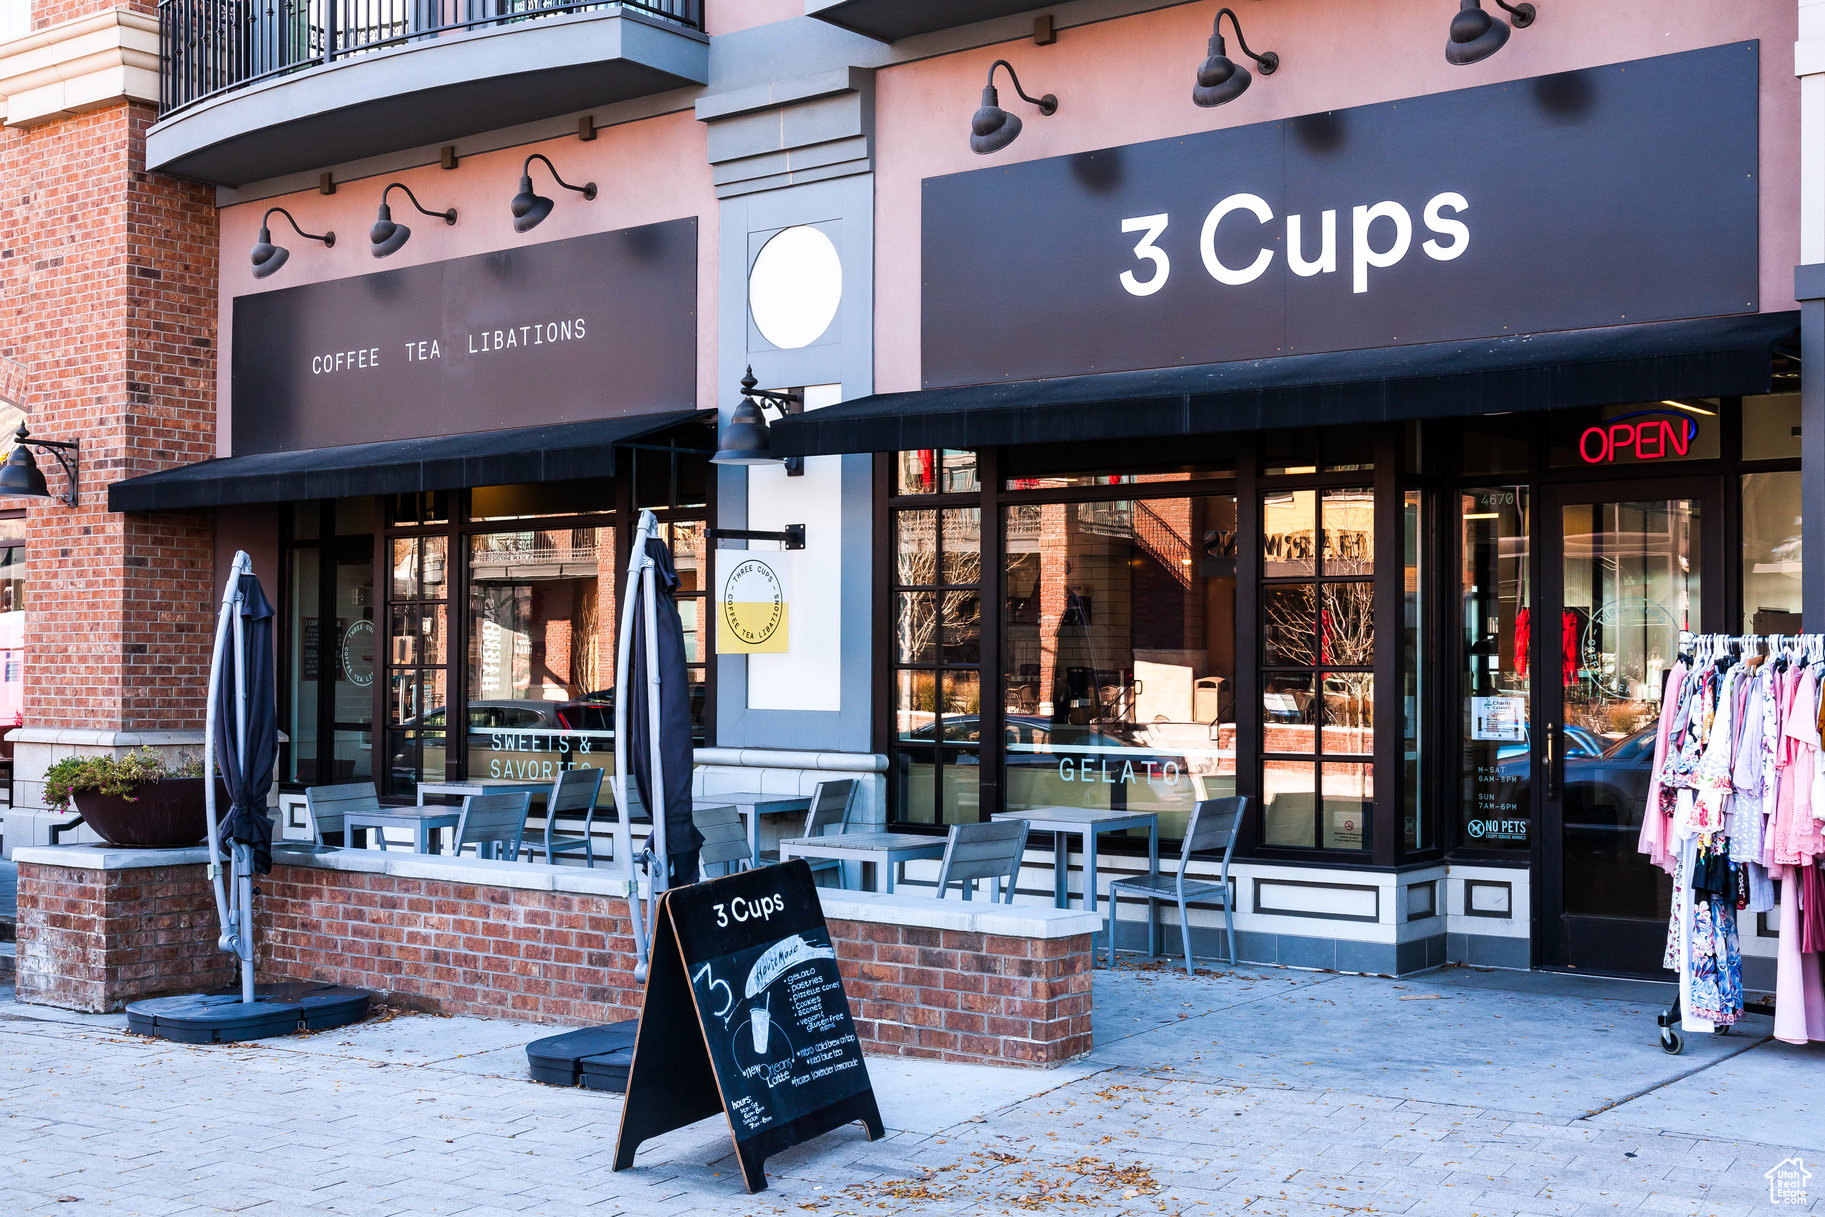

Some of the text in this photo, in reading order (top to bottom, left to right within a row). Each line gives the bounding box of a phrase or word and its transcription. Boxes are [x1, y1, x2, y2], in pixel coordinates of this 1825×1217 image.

[1119, 191, 1471, 297] 3 Cups
[312, 318, 586, 375] COFFEE TEA LIBATIONS
[1580, 418, 1689, 463] OPEN
[1480, 492, 1514, 505] 4670
[733, 564, 774, 583] THREE CUPS
[727, 593, 780, 640] COFFEE TEA LIBATIONS
[348, 623, 363, 639] THREE
[343, 646, 364, 682] COFFEE TEA
[491, 733, 592, 755] SWEETS &
[1059, 757, 1180, 786] GELATO
[1478, 766, 1506, 774] M-SAT
[1478, 775, 1517, 783] 6AM-8PM
[1478, 793, 1495, 801] SUN
[1478, 802, 1517, 811] 7AM-6PM
[1485, 819, 1526, 834] NO PETS
[713, 893, 784, 928] 3 Cups
[787, 967, 816, 985] gelato
[791, 975, 824, 994] pastries
[800, 1013, 821, 1025] vegan
[829, 1012, 844, 1022] free
[766, 1070, 791, 1089] Latte
